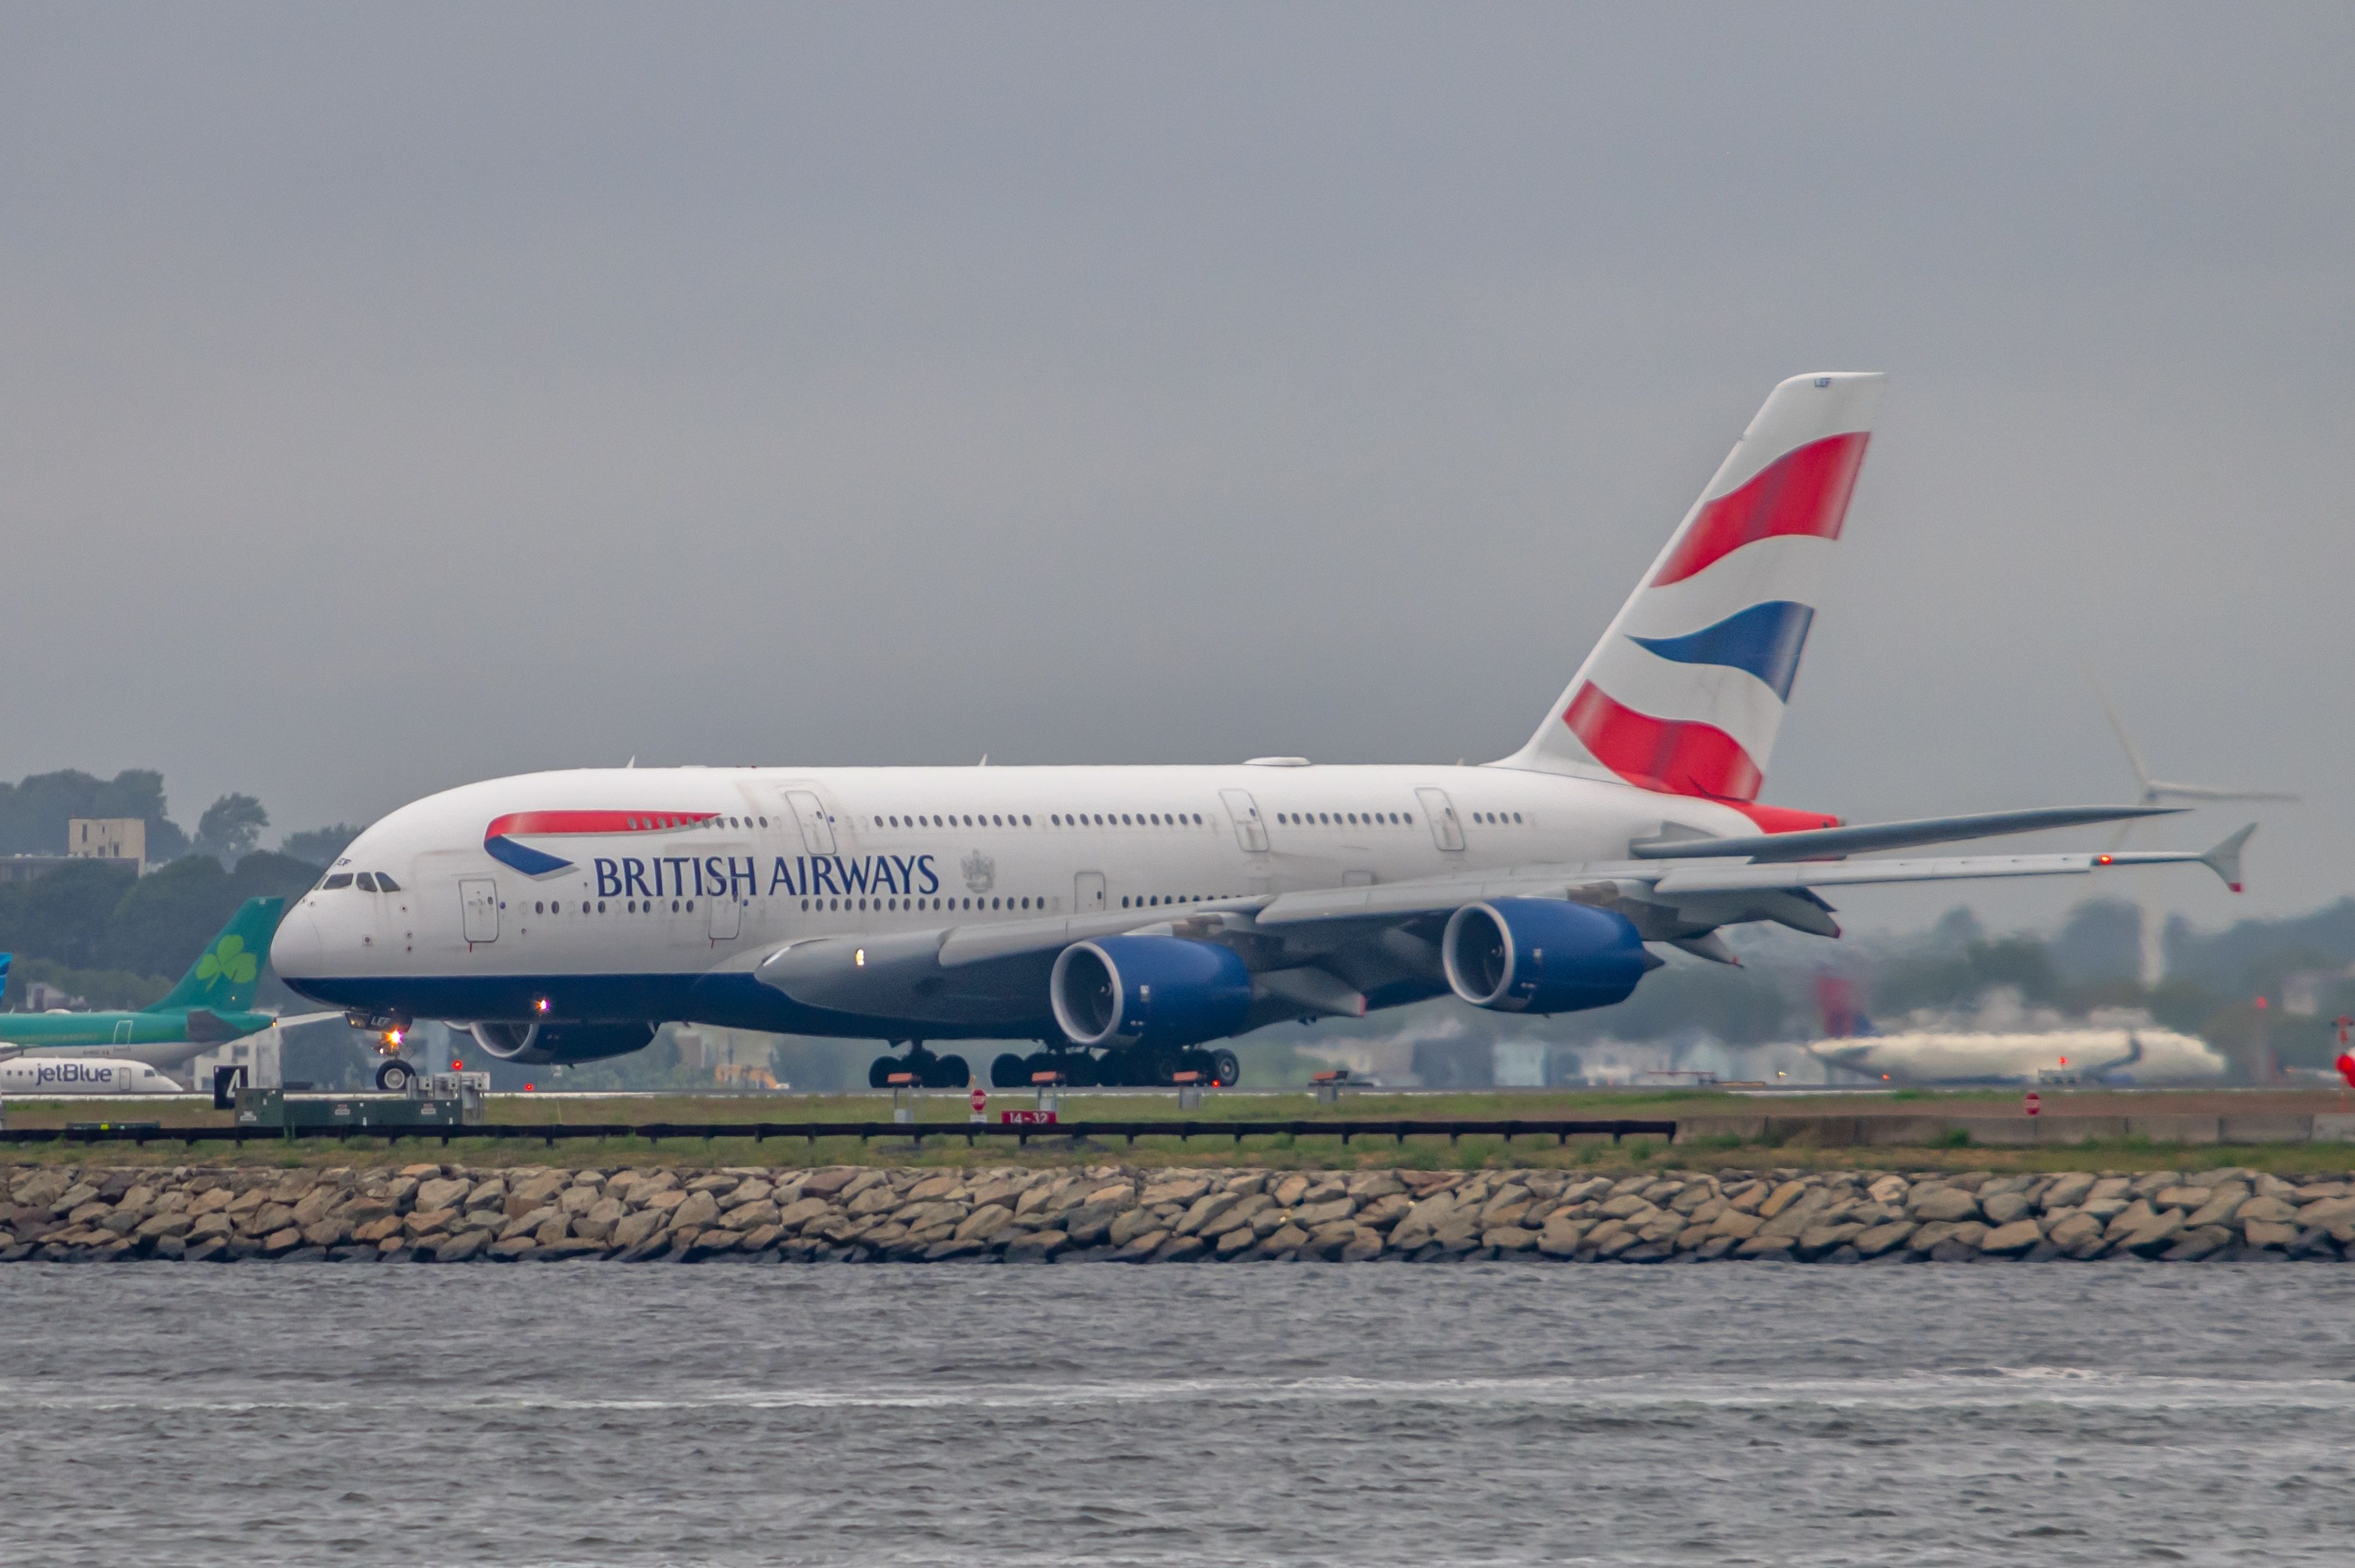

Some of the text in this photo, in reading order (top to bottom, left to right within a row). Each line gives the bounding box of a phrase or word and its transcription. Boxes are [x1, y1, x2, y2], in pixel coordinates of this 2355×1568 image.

[594, 855, 939, 897] BRITISH AIRWAYS
[36, 1063, 112, 1085] jetBlue
[226, 1069, 240, 1097] 4
[972, 1096, 985, 1104] STOP
[1010, 1112, 1048, 1124] 14-32
